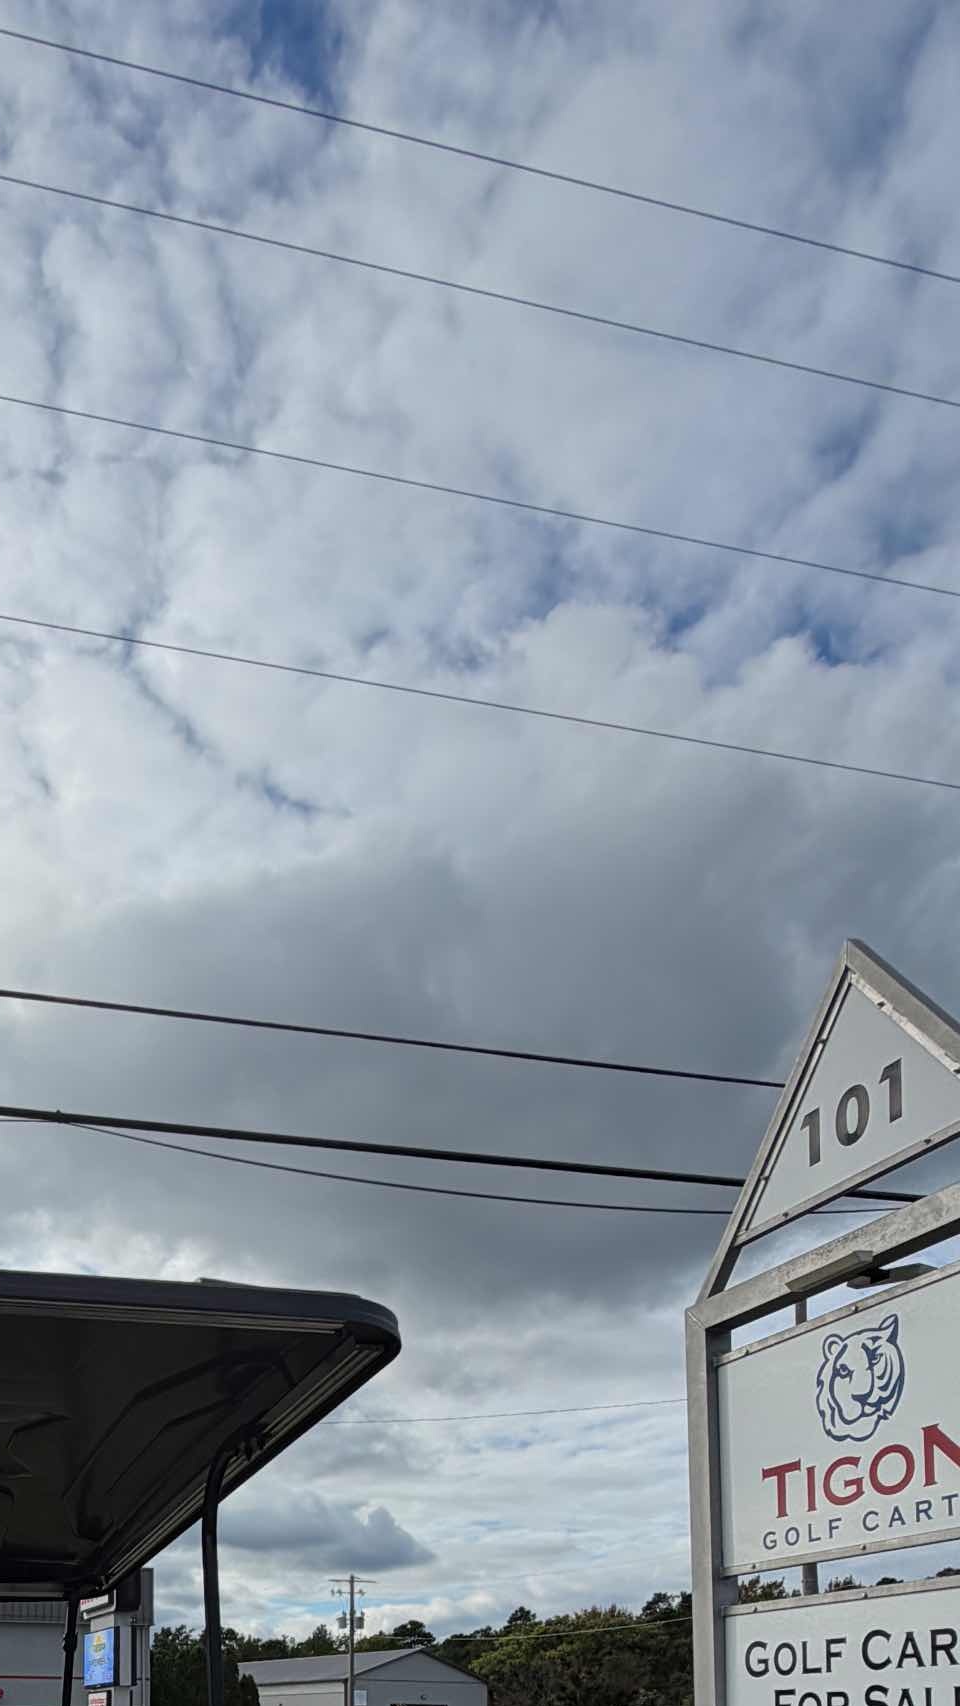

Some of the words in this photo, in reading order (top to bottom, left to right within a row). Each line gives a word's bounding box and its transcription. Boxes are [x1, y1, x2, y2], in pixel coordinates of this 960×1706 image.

[800, 1057, 903, 1168] 101
[762, 1424, 960, 1519] TIGON
[763, 1517, 842, 1550] GOLF
[745, 1637, 847, 1678] GOLF
